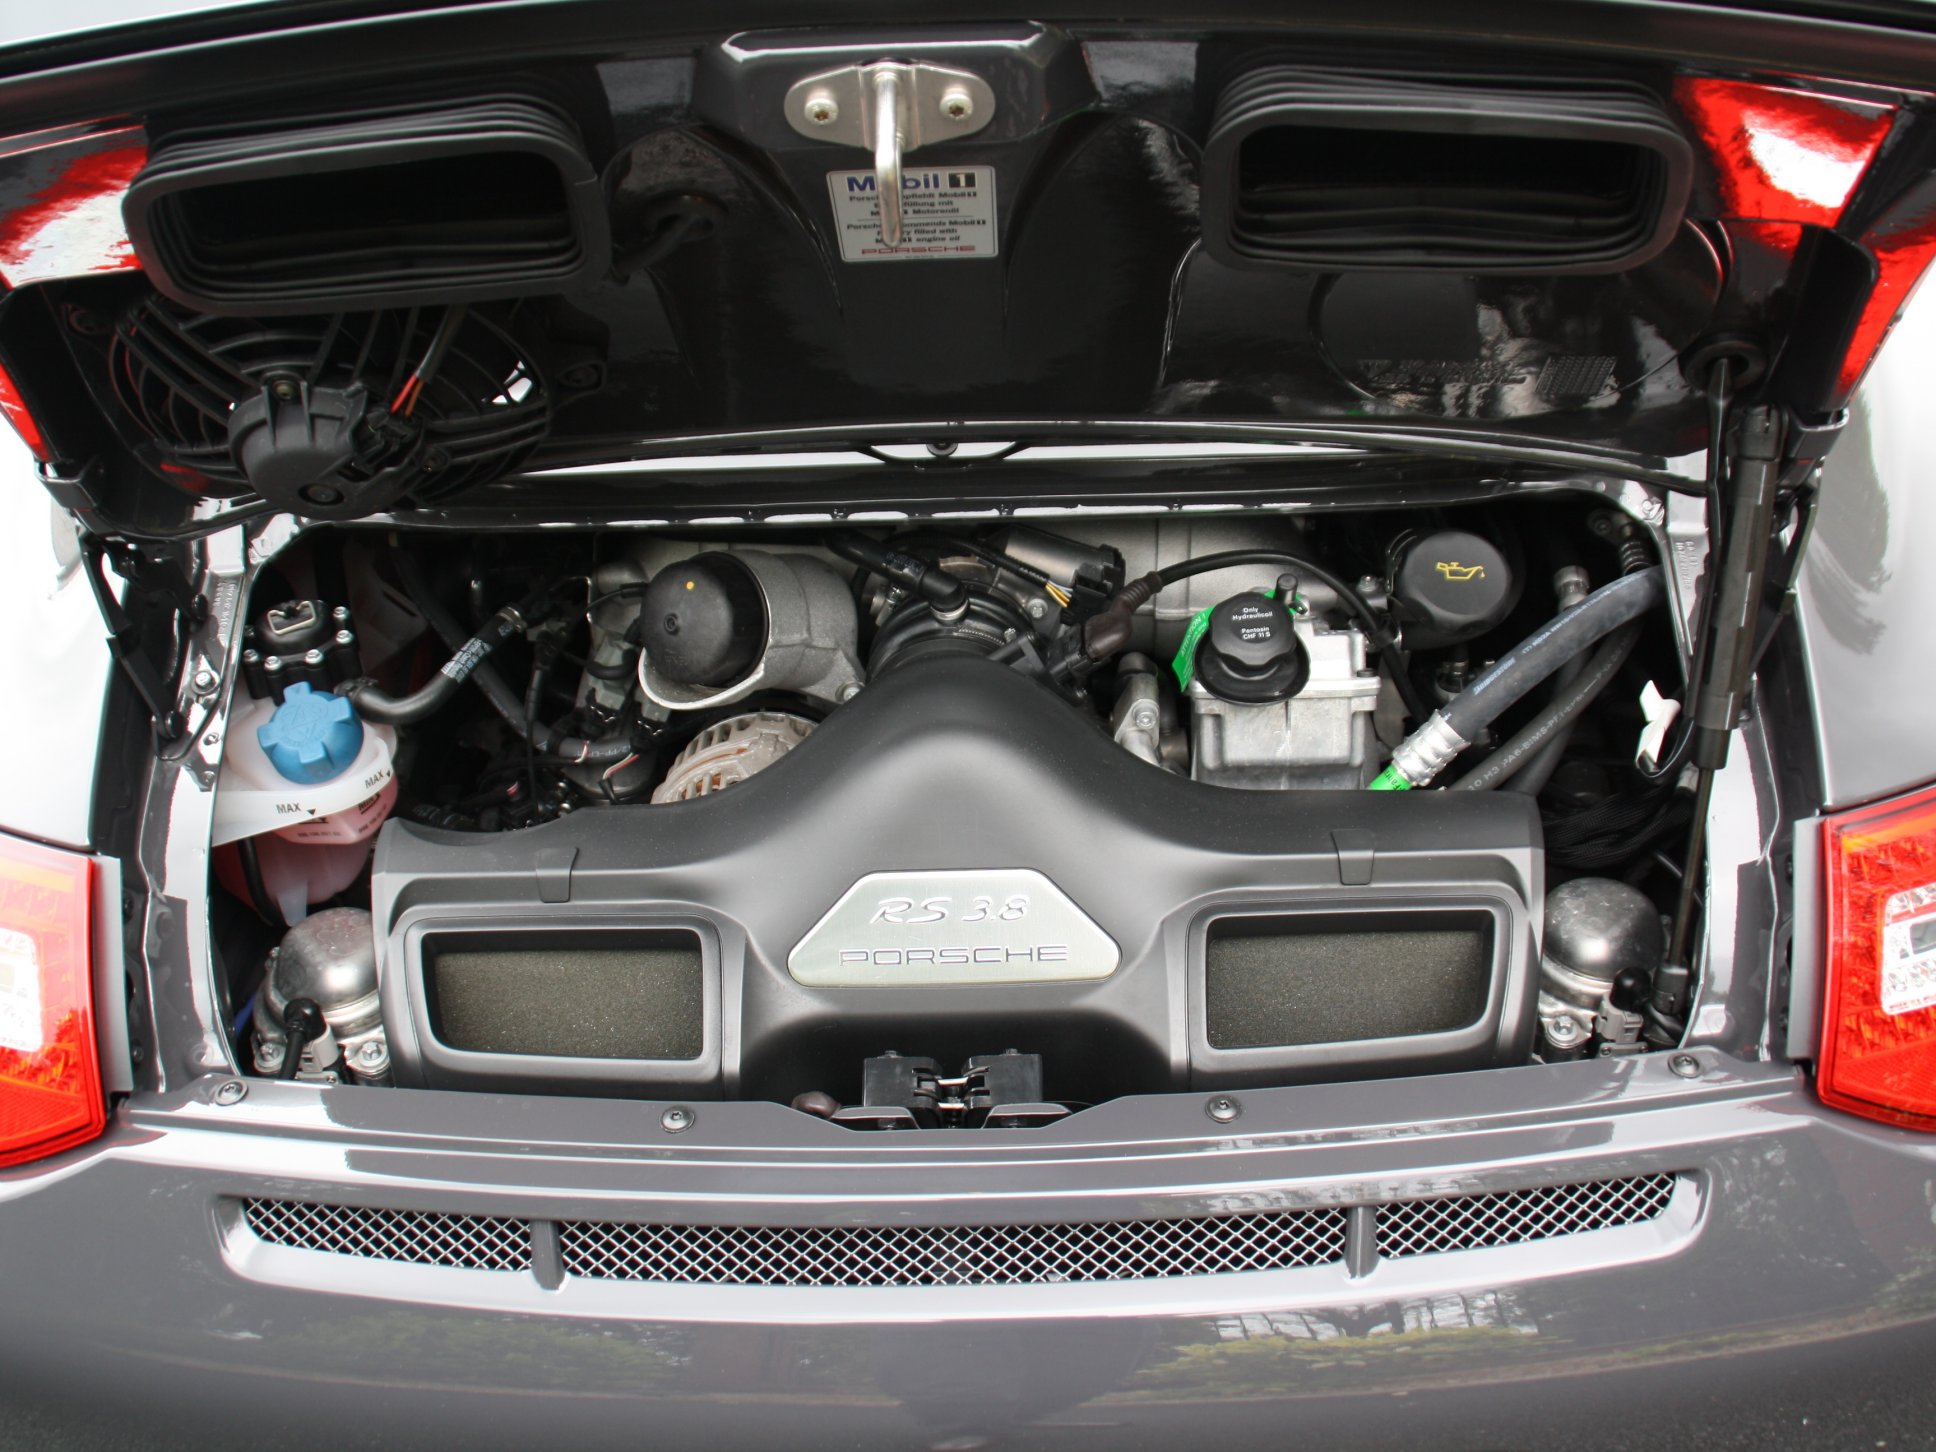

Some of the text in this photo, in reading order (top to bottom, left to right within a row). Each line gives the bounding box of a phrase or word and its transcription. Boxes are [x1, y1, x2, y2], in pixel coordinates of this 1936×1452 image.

[847, 172, 940, 192] Mbil
[862, 245, 976, 255] PORSCHE
[365, 768, 384, 789] MAX
[276, 802, 302, 815] MAX
[869, 894, 1031, 924] RS 3.8
[839, 945, 1068, 967] PORSCHE
